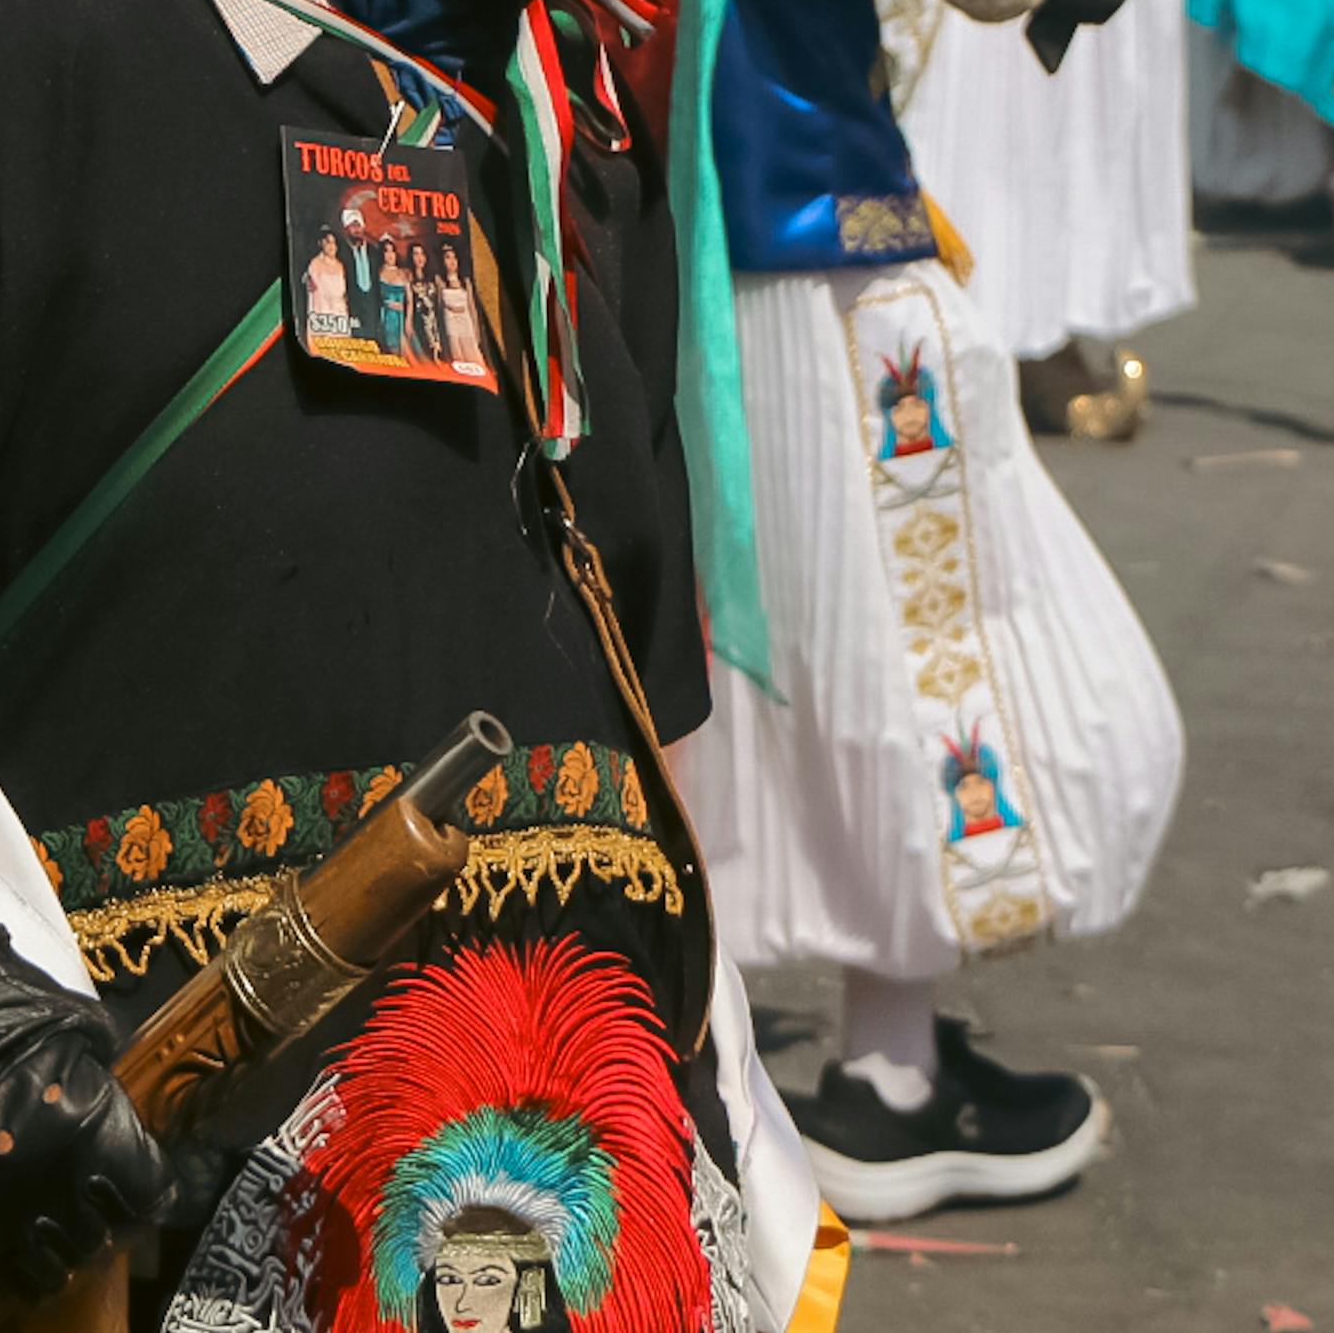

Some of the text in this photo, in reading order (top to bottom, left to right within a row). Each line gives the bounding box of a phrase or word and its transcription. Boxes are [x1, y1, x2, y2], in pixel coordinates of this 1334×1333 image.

[294, 141, 411, 182] TURCOS DEL
[378, 186, 460, 219] CENTRO
